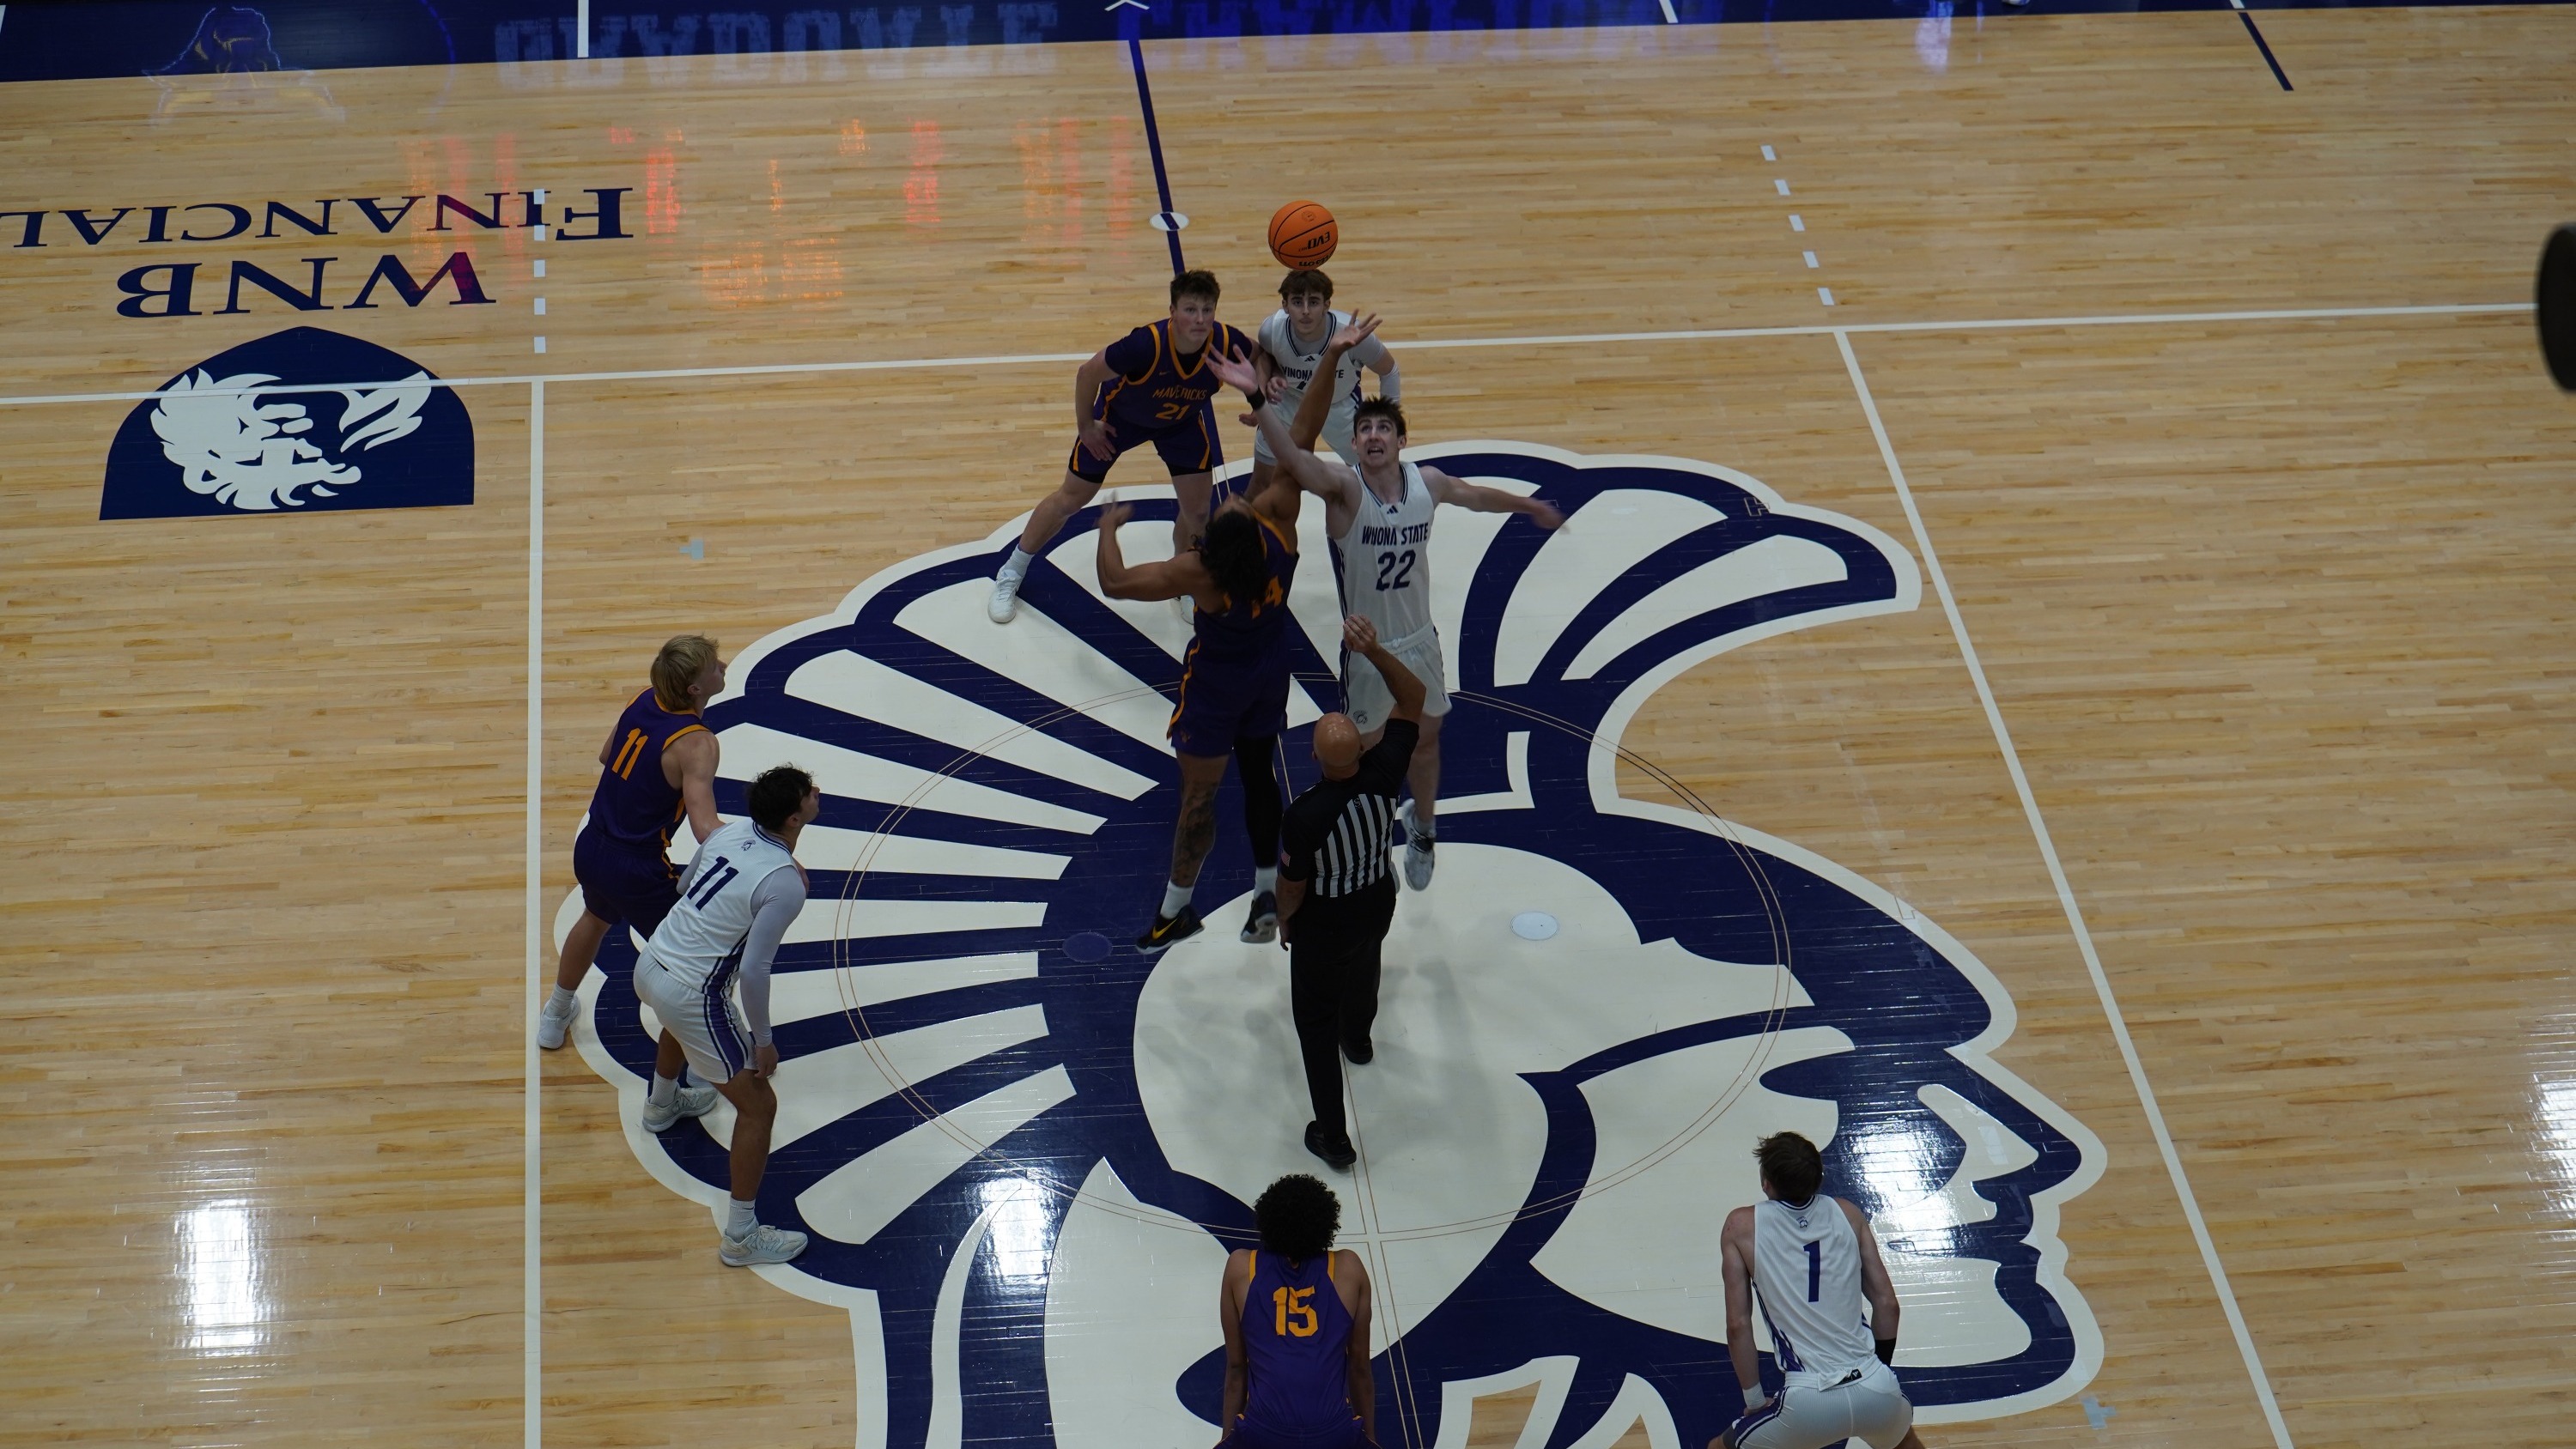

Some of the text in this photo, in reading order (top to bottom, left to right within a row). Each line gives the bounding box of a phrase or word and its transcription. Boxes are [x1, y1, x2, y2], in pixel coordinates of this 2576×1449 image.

[0, 187, 634, 248] FINANCIAL
[117, 252, 496, 318] WNB
[1151, 385, 1207, 401] MAVERICKS
[1155, 402, 1191, 421] 21
[1400, 522, 1429, 546] STATE
[1376, 549, 1416, 591] 22
[611, 727, 649, 781] 11
[686, 856, 739, 911] 11
[1803, 1240, 1820, 1303] 1
[1273, 1284, 1319, 1338] 15
